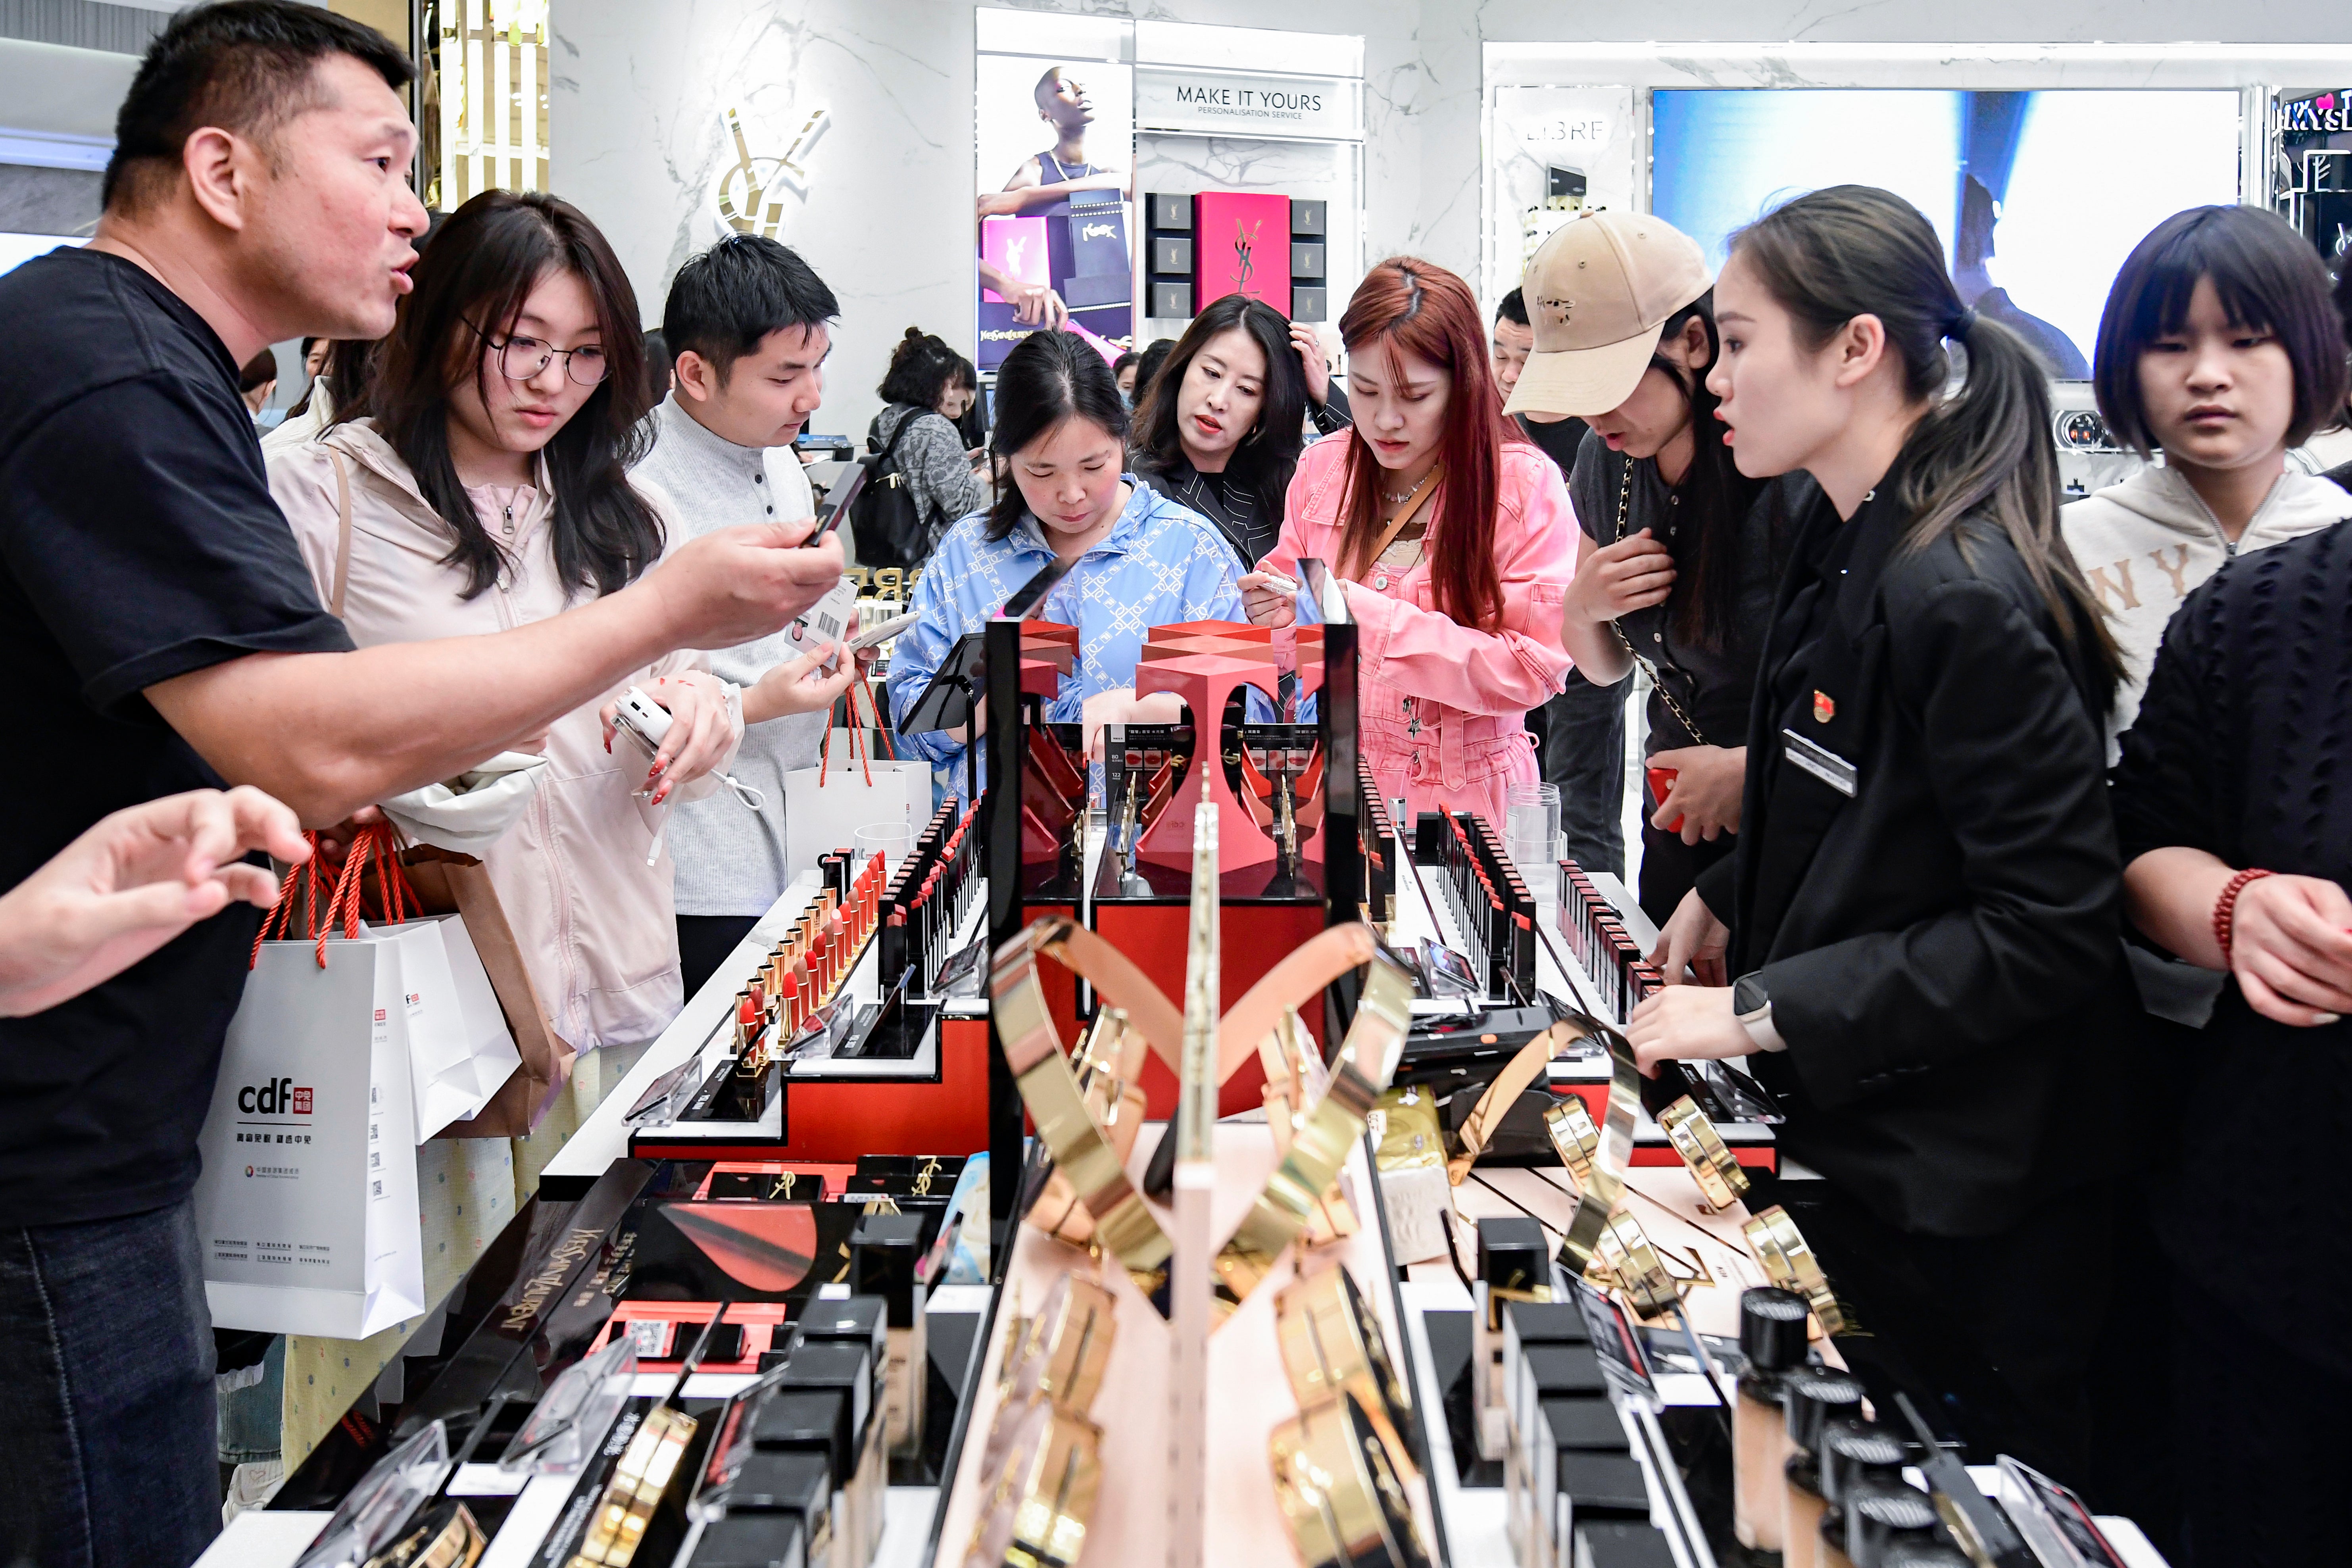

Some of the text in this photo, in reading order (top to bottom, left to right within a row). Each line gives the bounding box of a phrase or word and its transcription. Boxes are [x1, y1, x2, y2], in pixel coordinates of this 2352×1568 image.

[1177, 86, 1321, 111] MAKE IT YOURS
[1198, 106, 1269, 117] PERSONALISATION
[238, 1078, 292, 1114] cdf
